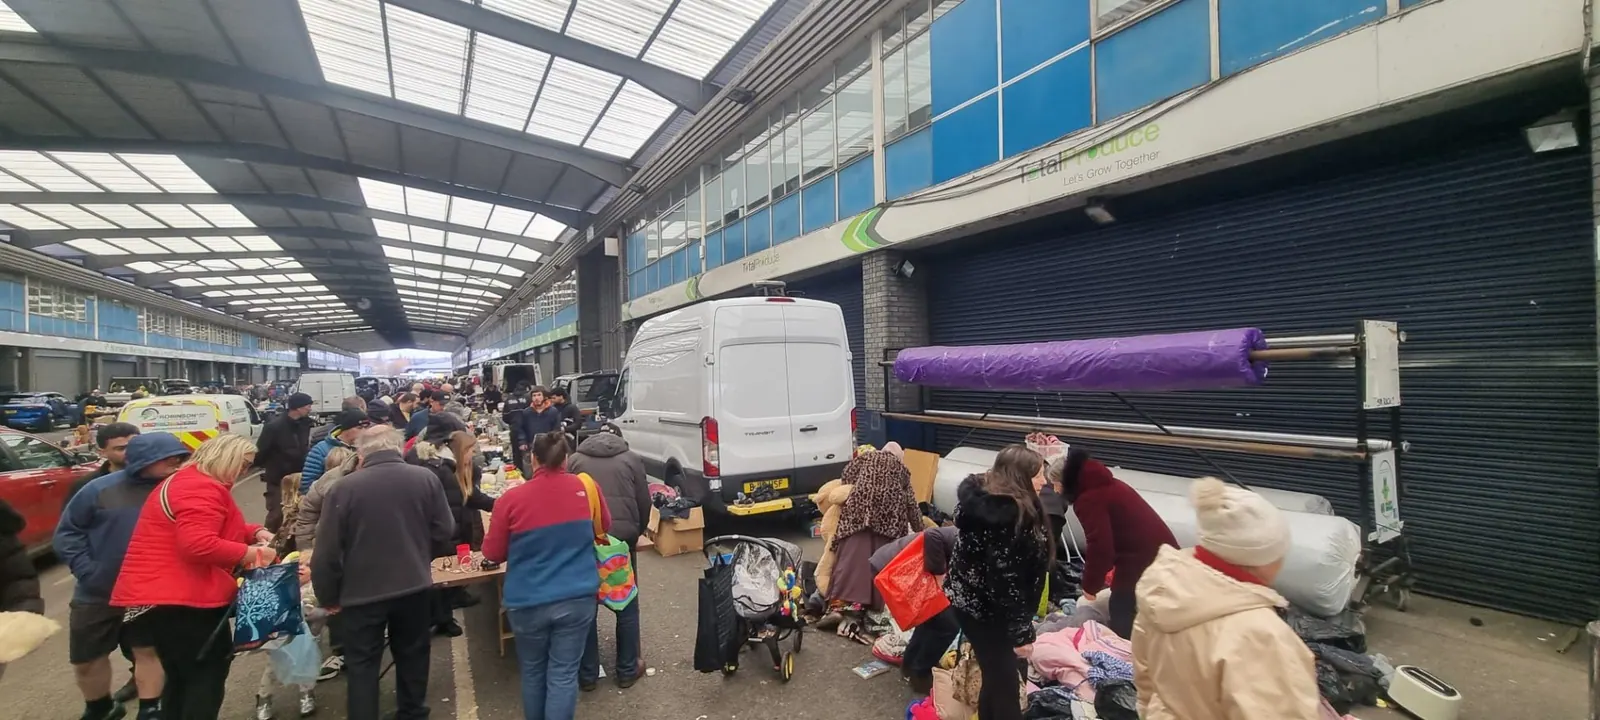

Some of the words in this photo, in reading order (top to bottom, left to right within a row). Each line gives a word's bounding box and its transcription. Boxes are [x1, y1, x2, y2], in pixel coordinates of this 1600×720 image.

[1063, 174, 1084, 186] Let's
[1086, 164, 1113, 180] Grow
[1115, 150, 1160, 170] Together
